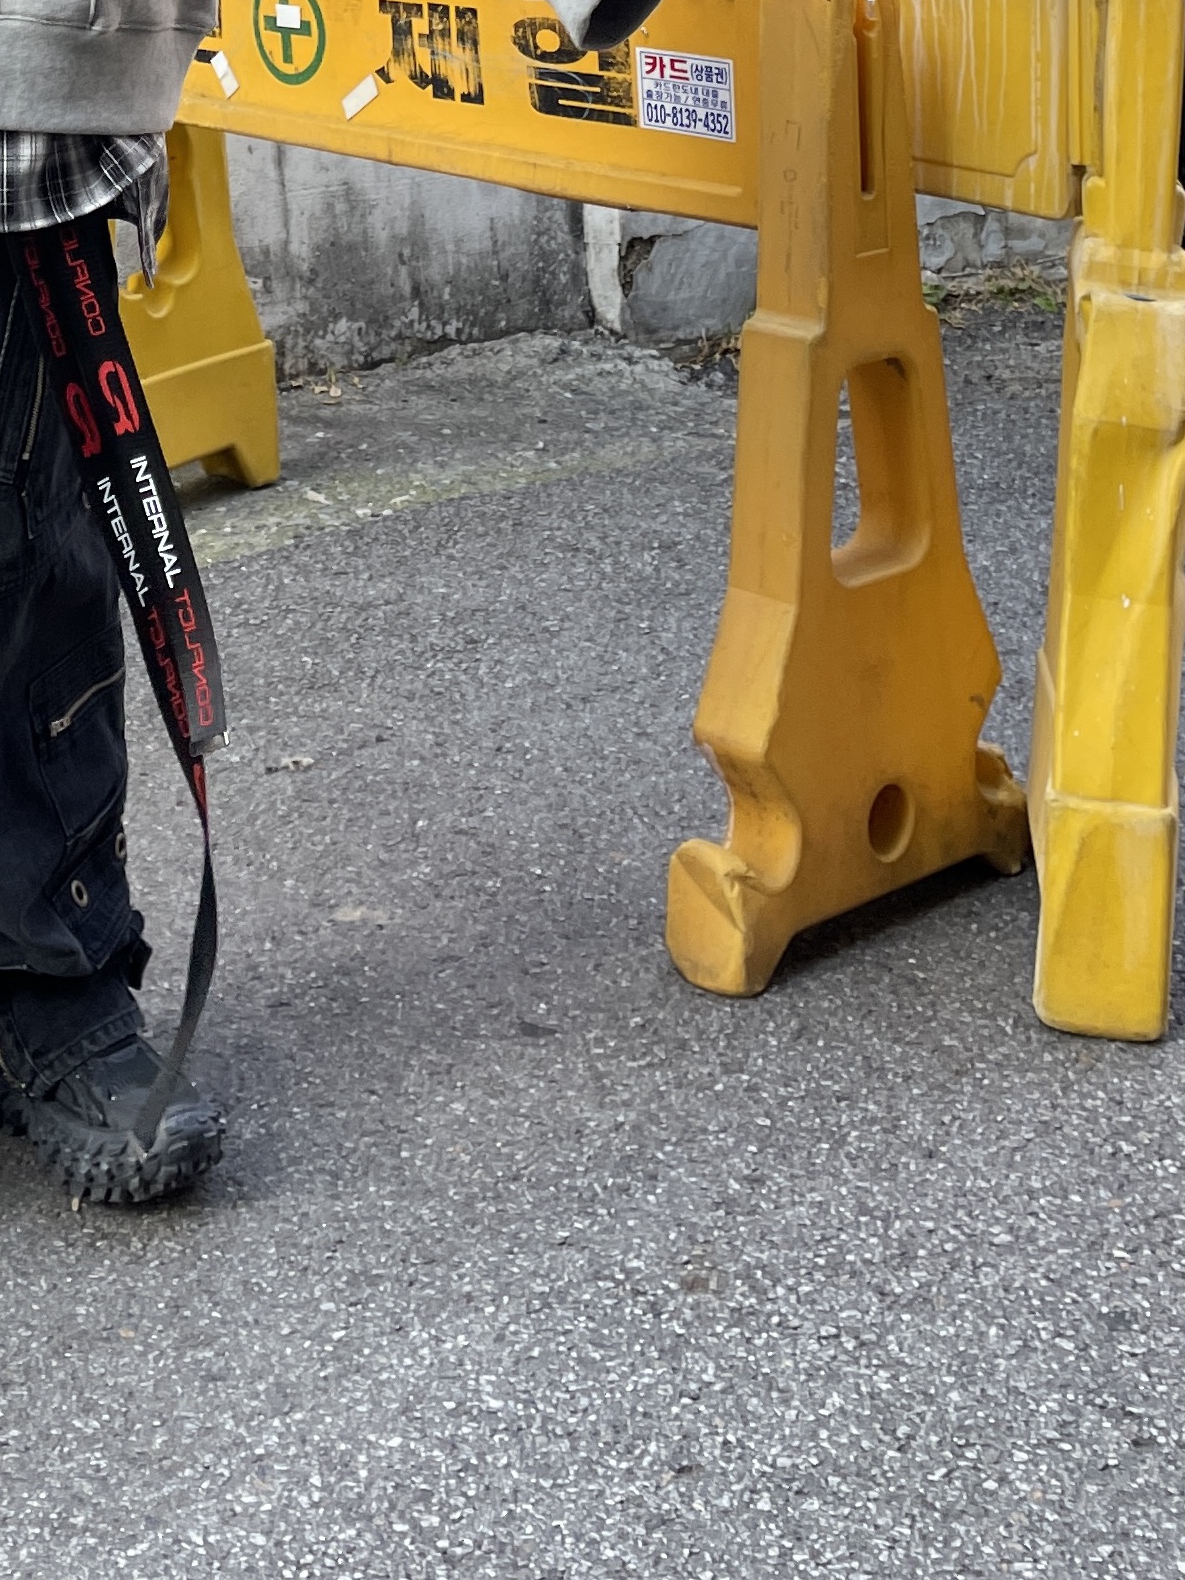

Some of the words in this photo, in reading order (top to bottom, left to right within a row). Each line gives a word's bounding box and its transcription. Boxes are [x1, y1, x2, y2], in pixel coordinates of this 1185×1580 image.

[644, 54, 689, 81] 카드
[690, 62, 728, 85] (상품권)
[646, 102, 729, 135] 010-8139-4352
[97, 477, 147, 607] INTERNAL
[130, 455, 181, 588] INTERNAL
